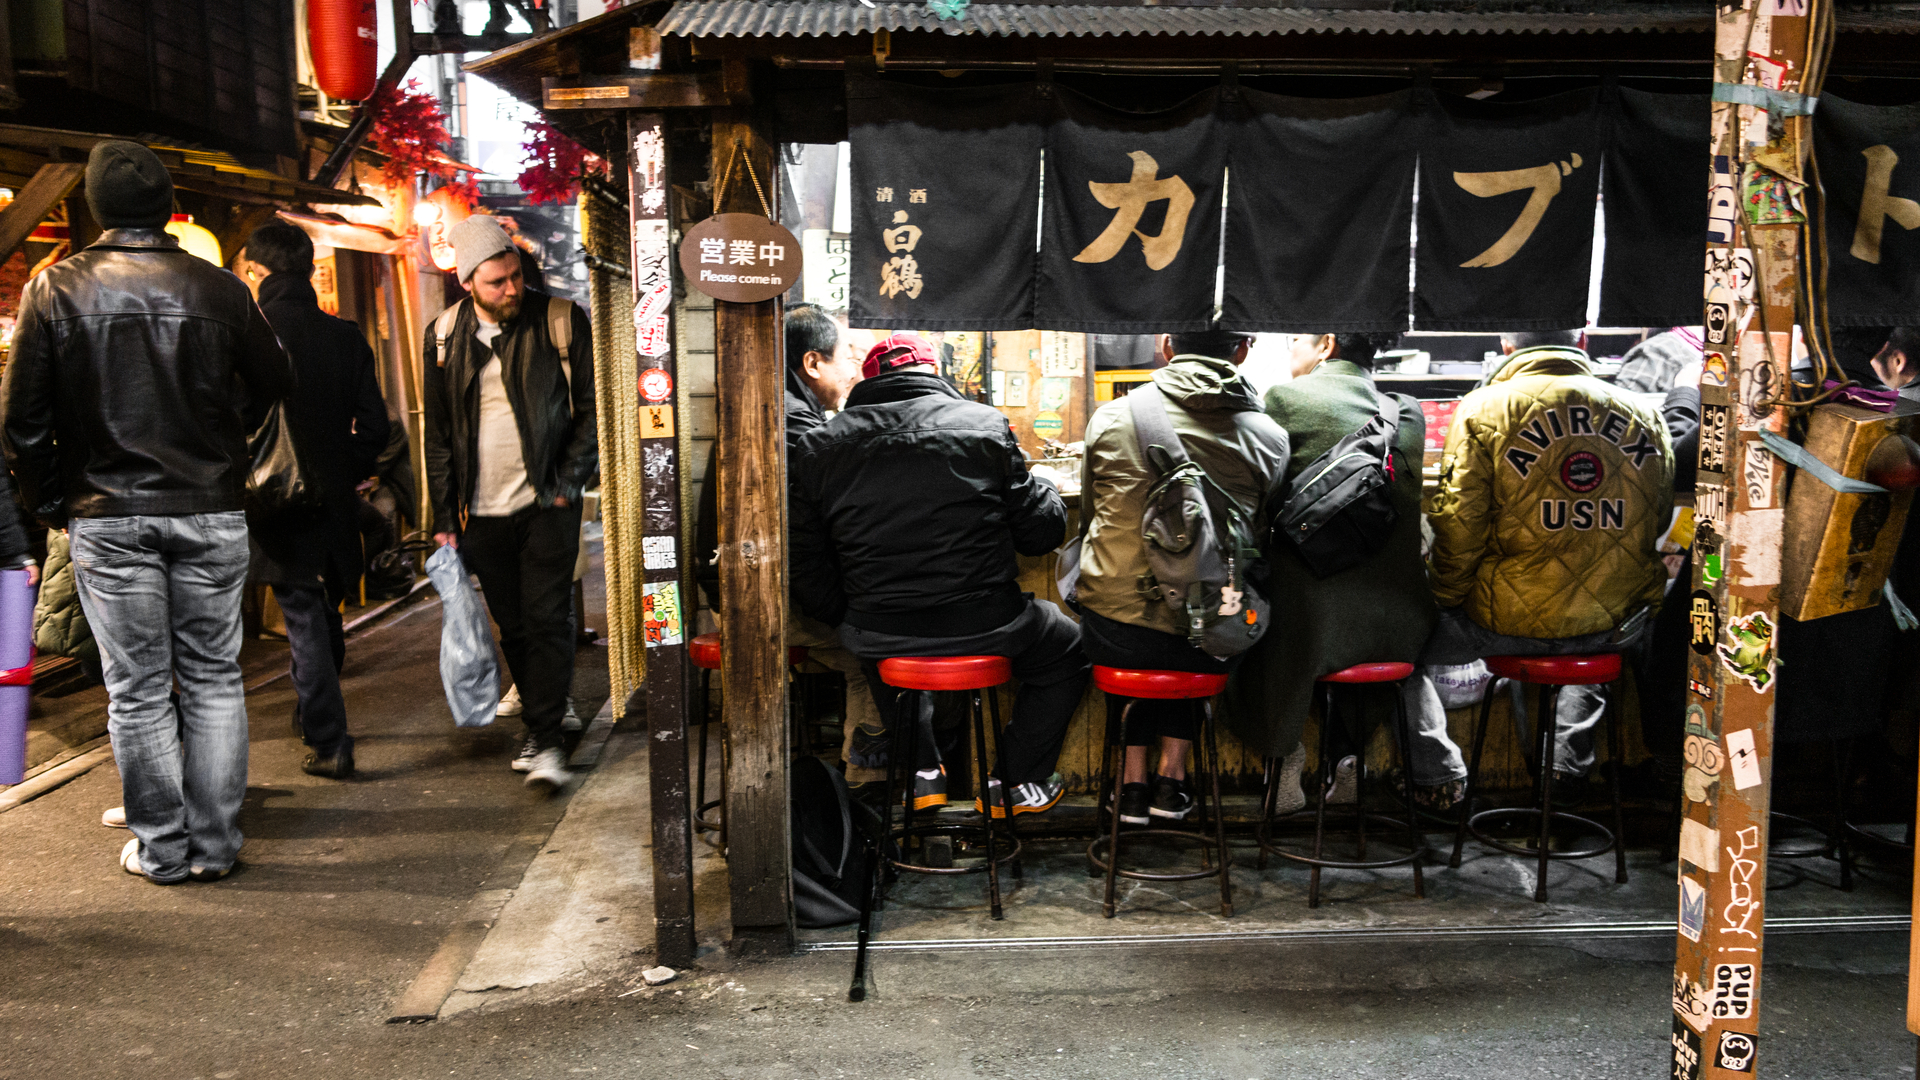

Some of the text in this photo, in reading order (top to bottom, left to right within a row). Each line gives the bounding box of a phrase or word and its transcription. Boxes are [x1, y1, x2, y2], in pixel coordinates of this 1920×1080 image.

[700, 238, 784, 267] 営業中
[879, 209, 924, 300] 白鶴
[700, 269, 782, 285] Please come in
[1504, 405, 1662, 480] AVIREX
[1712, 411, 1726, 467] OVER
[1541, 498, 1625, 531] USN
[1713, 965, 1732, 1016] one
[1731, 965, 1752, 1015] PUP
[1672, 1032, 1698, 1066] LOVE
[1675, 1049, 1693, 1073] MY
